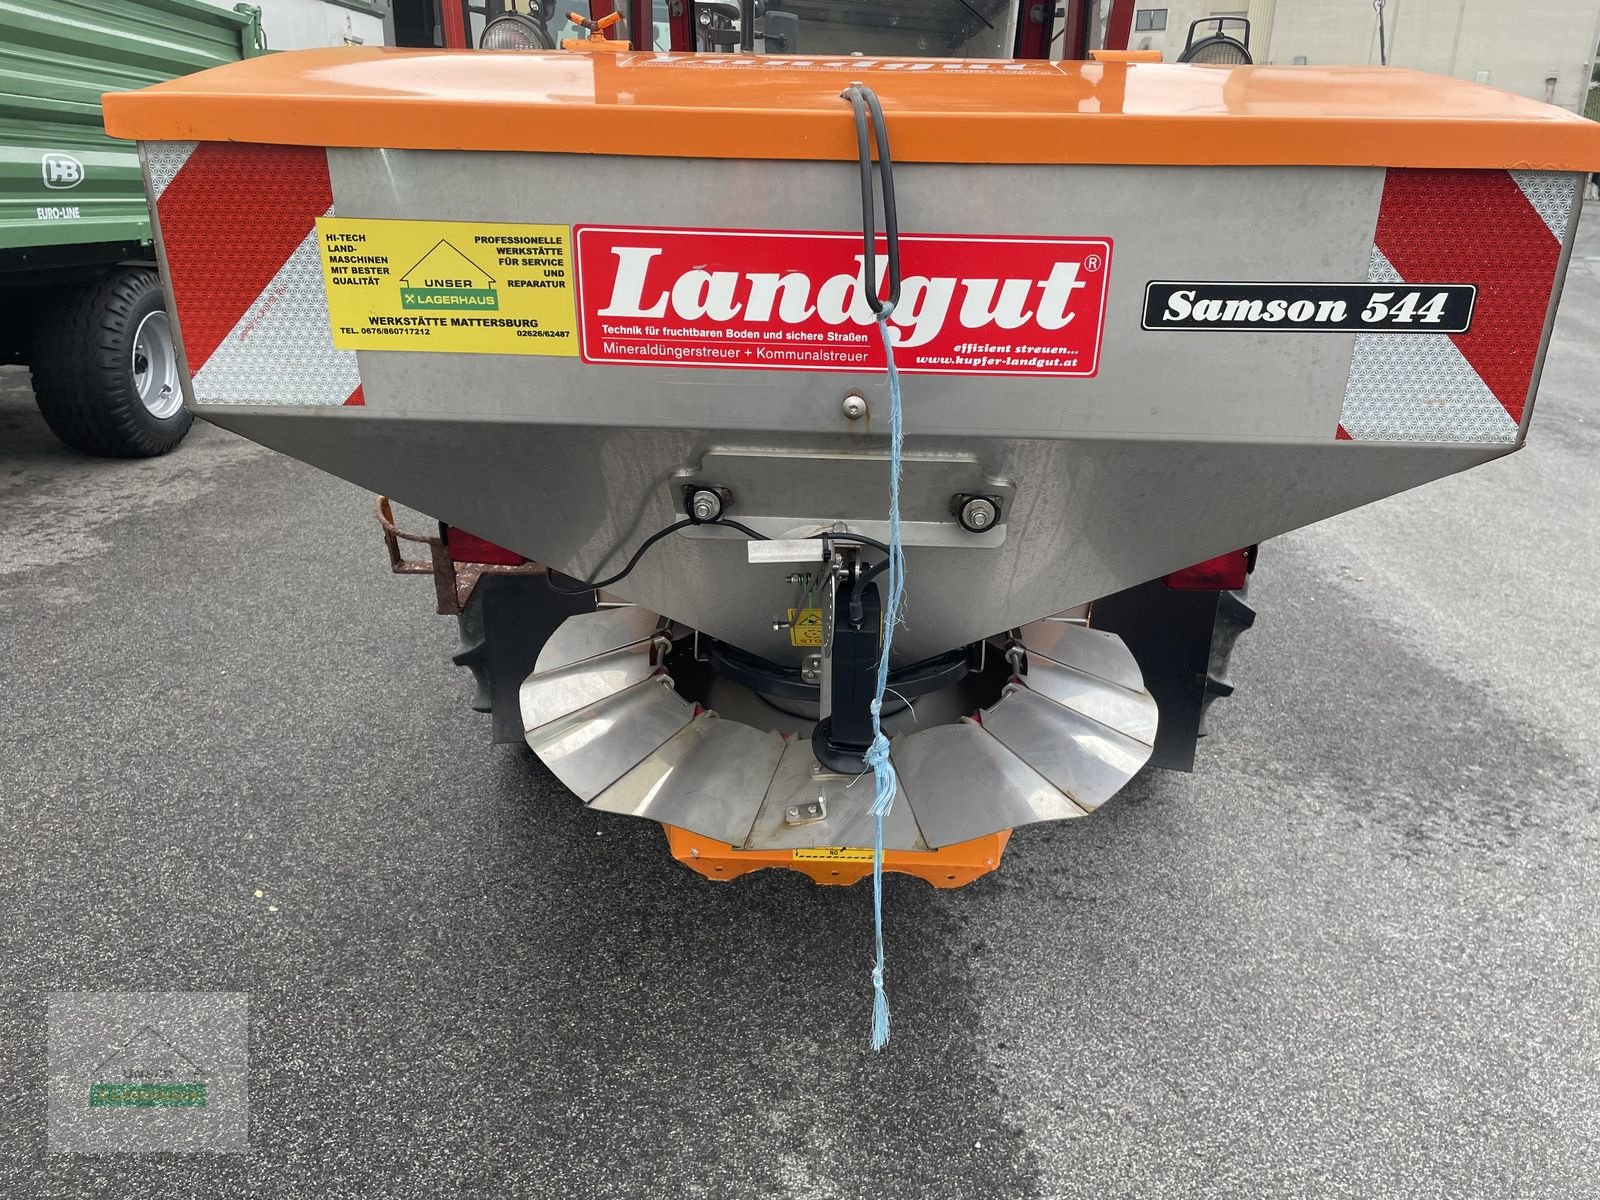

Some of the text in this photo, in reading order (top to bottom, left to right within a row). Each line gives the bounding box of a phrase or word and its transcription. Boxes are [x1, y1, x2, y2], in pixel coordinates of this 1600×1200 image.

[48, 160, 79, 182] HB
[37, 207, 80, 219] EURO-LINE
[326, 234, 366, 242] HI-TECH
[474, 236, 562, 244] PROFESSIONELLE
[496, 247, 563, 255] WERKSTÄTTE
[329, 256, 389, 264] MASCHINEN
[499, 258, 519, 266] FÜR
[333, 277, 380, 285] QUALITÄT
[507, 280, 565, 288] REPARATUR
[418, 295, 495, 305] LAGERHAUS
[597, 246, 1086, 348] Landgut
[1162, 290, 1449, 323] Samson 544
[369, 316, 538, 327] WERKSTÄTTE MATTERSBURG
[517, 330, 570, 338] 02626/62487
[602, 324, 868, 342] Technik für fruchtbaren Boden und sichere Straßen
[603, 342, 740, 359] Mineraldüngerstreuer
[757, 347, 868, 361] Kommunalstreuer
[953, 343, 1079, 354] effizient streuen...
[916, 355, 1078, 368] www.kupfer-landgut.at
